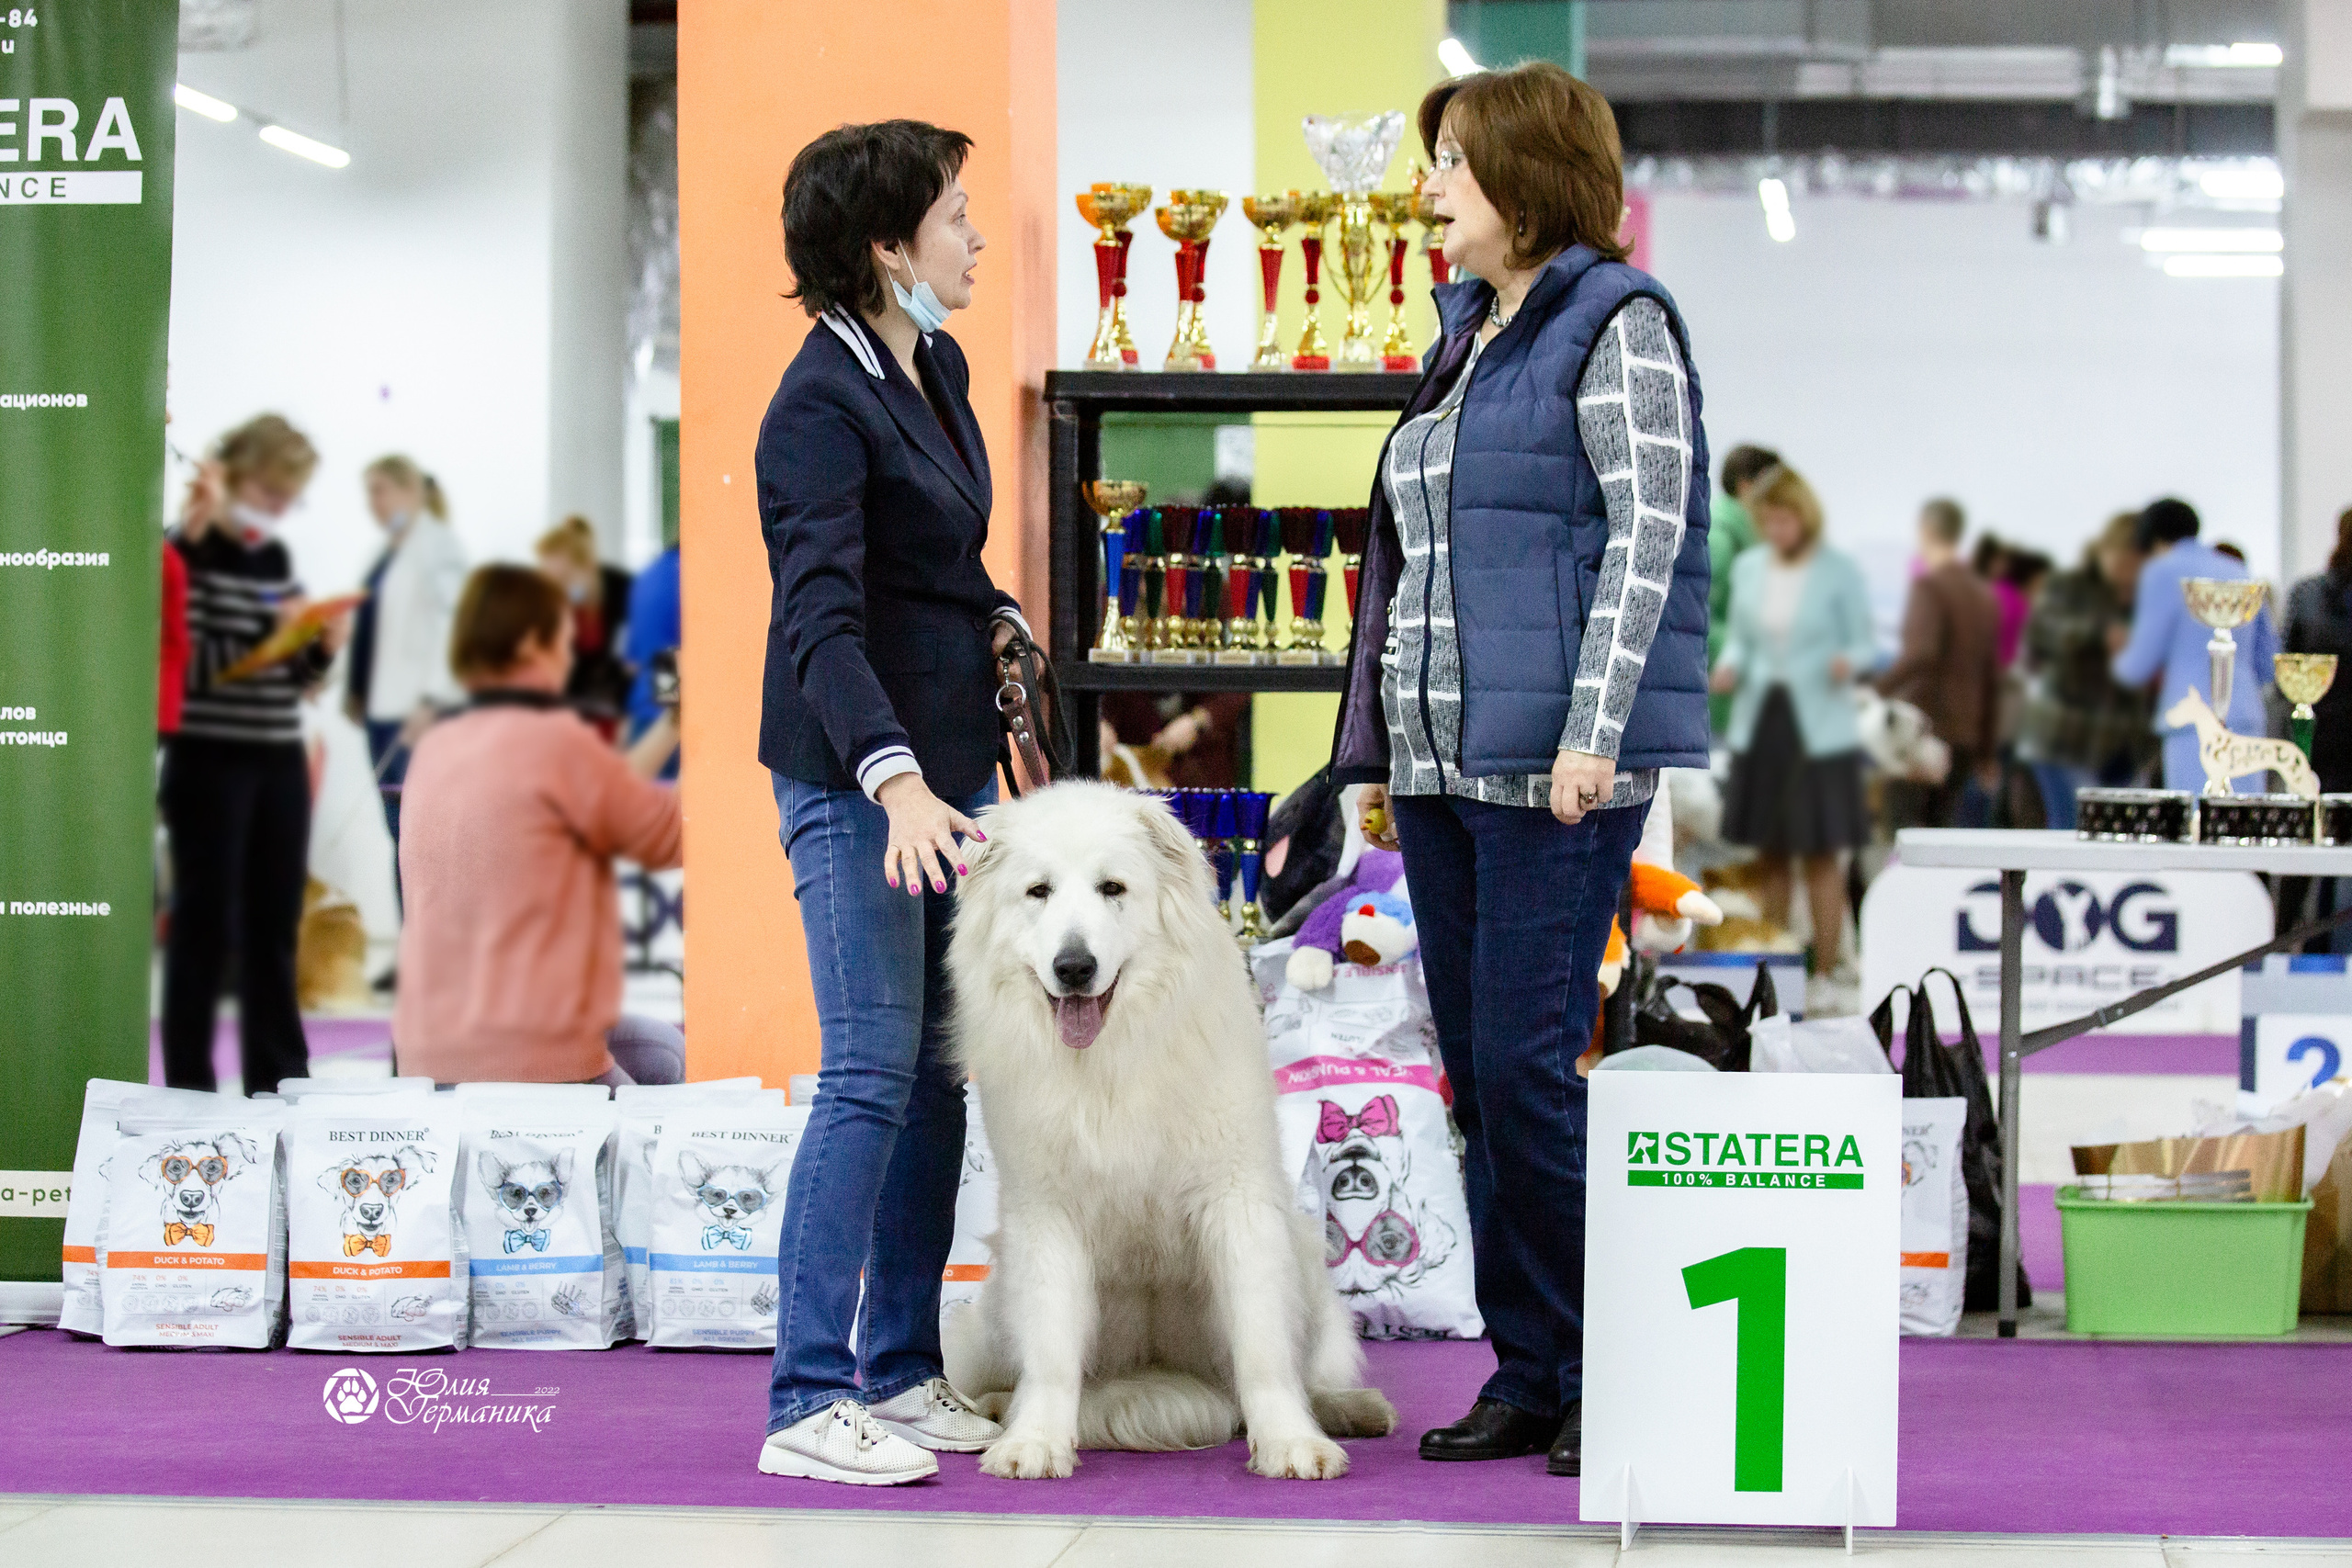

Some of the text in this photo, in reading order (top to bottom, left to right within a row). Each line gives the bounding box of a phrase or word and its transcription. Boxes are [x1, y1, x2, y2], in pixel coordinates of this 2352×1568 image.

[0, 393, 88, 411] ационов
[10, 901, 111, 916] полезные
[2288, 1035, 2340, 1089] 2
[329, 1130, 366, 1142] BEST
[1665, 1131, 1864, 1168] STATERA
[1662, 1173, 1826, 1188] 100% BALANCE
[153, 1256, 225, 1266] DUCK & POTATO
[528, 1262, 557, 1270] BERRY
[333, 1267, 358, 1275] DUCK
[368, 1267, 402, 1276] POTATO
[1680, 1247, 1787, 1493] 1
